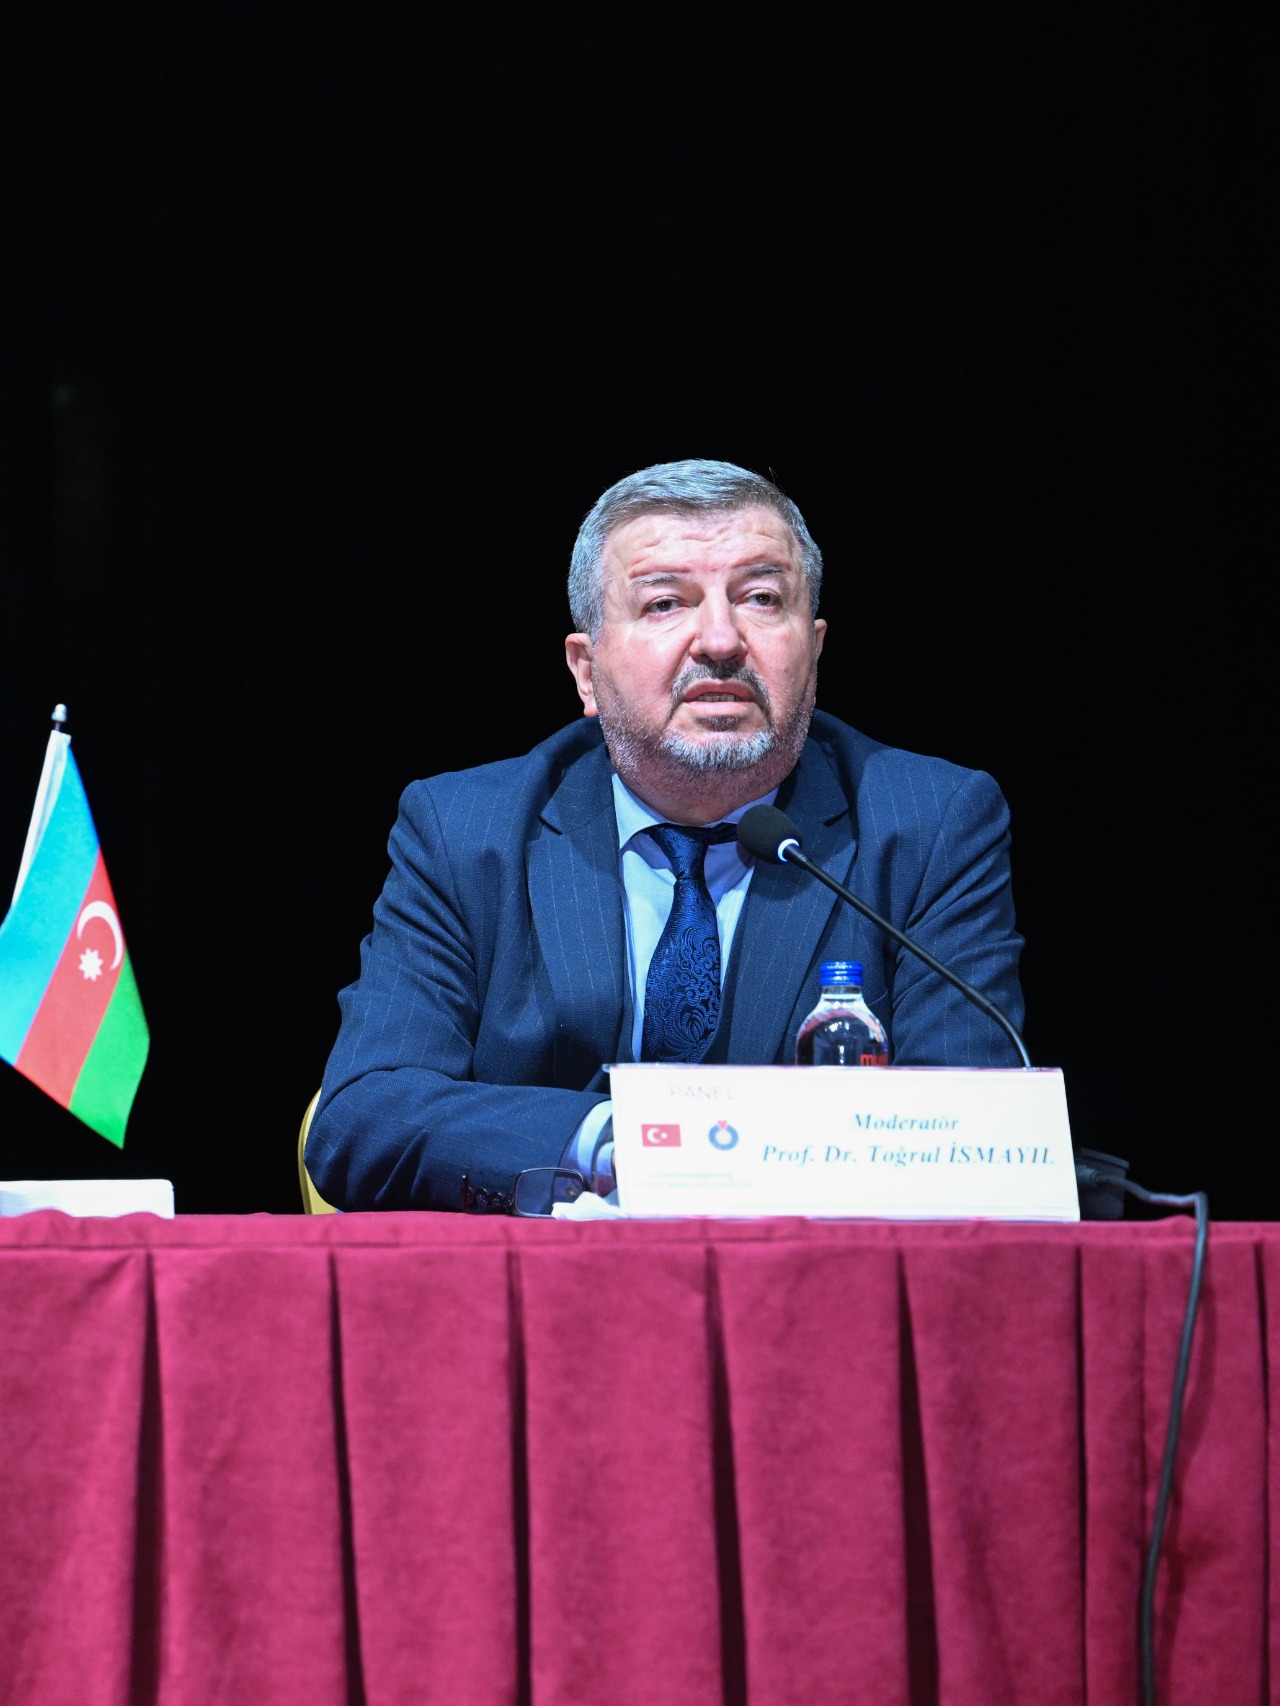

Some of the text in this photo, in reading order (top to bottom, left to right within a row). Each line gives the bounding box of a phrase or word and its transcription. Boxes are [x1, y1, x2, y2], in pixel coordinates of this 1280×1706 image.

[670, 1085, 737, 1101] PANEL
[852, 1112, 960, 1131] Moderatör
[761, 1140, 1057, 1168] Prof. Dr. Toğrul İSMAYIL
